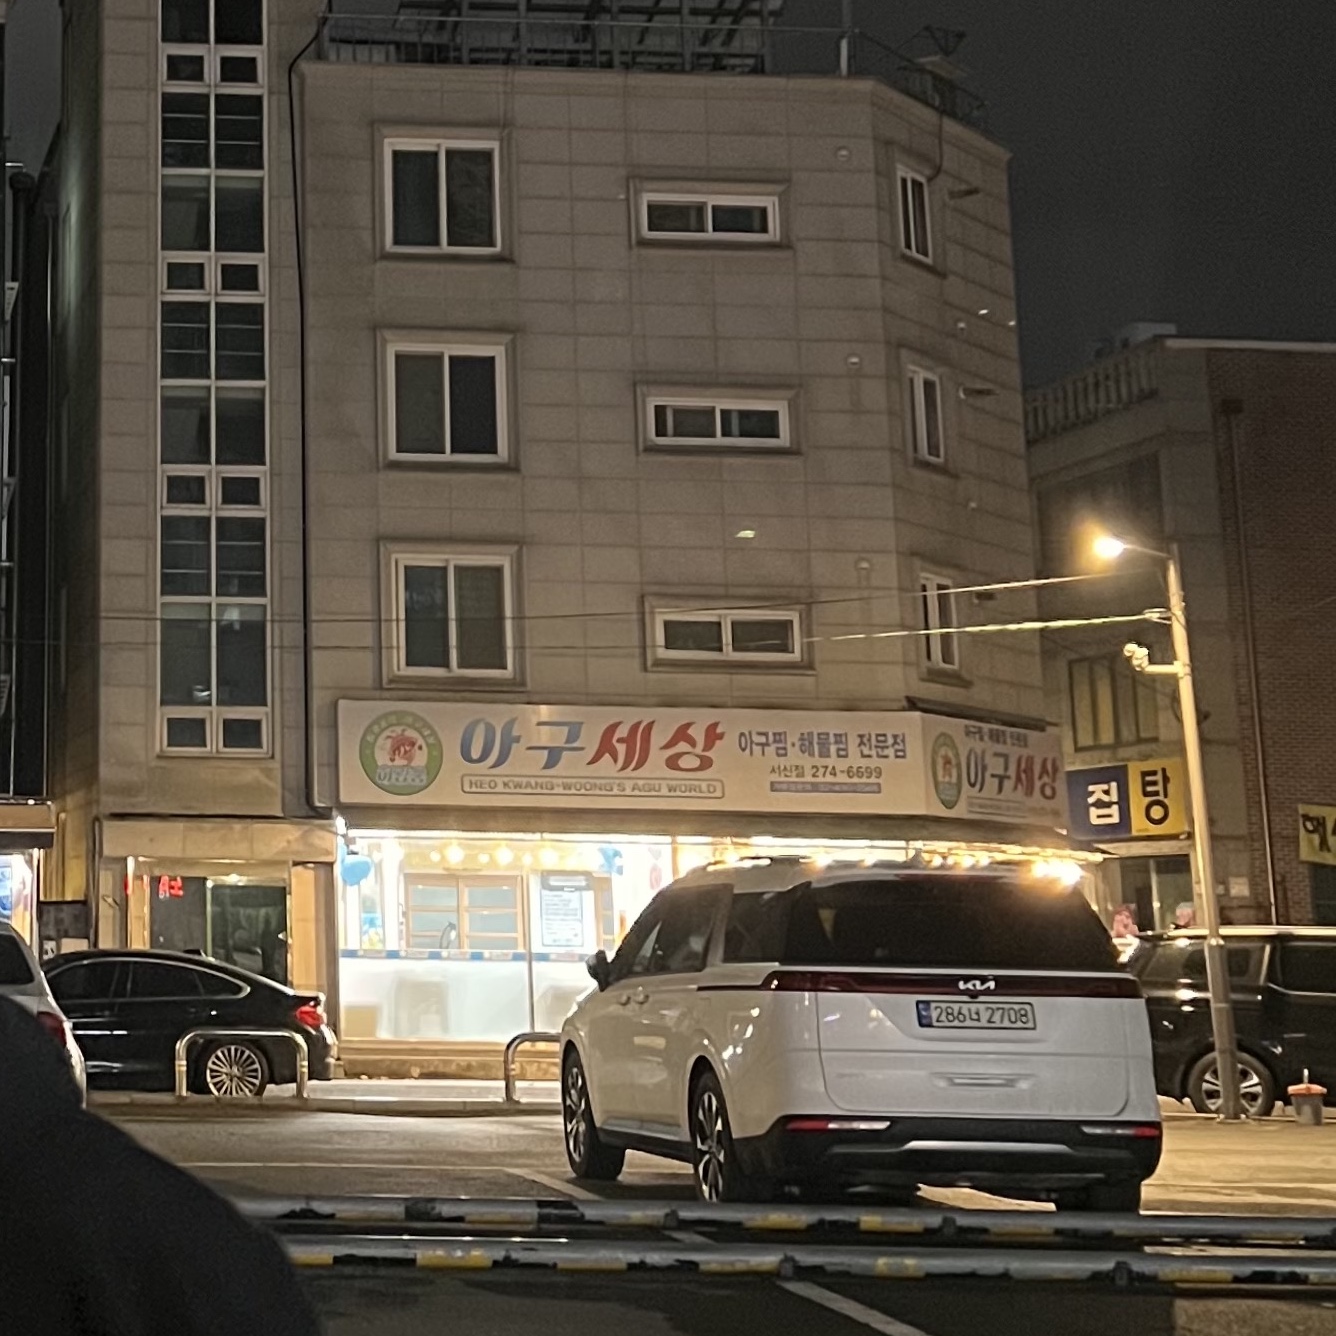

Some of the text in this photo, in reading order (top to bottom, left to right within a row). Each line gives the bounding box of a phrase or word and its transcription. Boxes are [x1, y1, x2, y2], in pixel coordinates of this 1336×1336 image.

[459, 716, 726, 773] 아구세상
[856, 732, 907, 759] 전문점
[811, 765, 883, 779] 274-6699
[965, 746, 1060, 800] 아구세상
[666, 783, 717, 796] WORLD
[1087, 767, 1171, 826] 집 탕
[985, 1006, 1030, 1025] 2708
